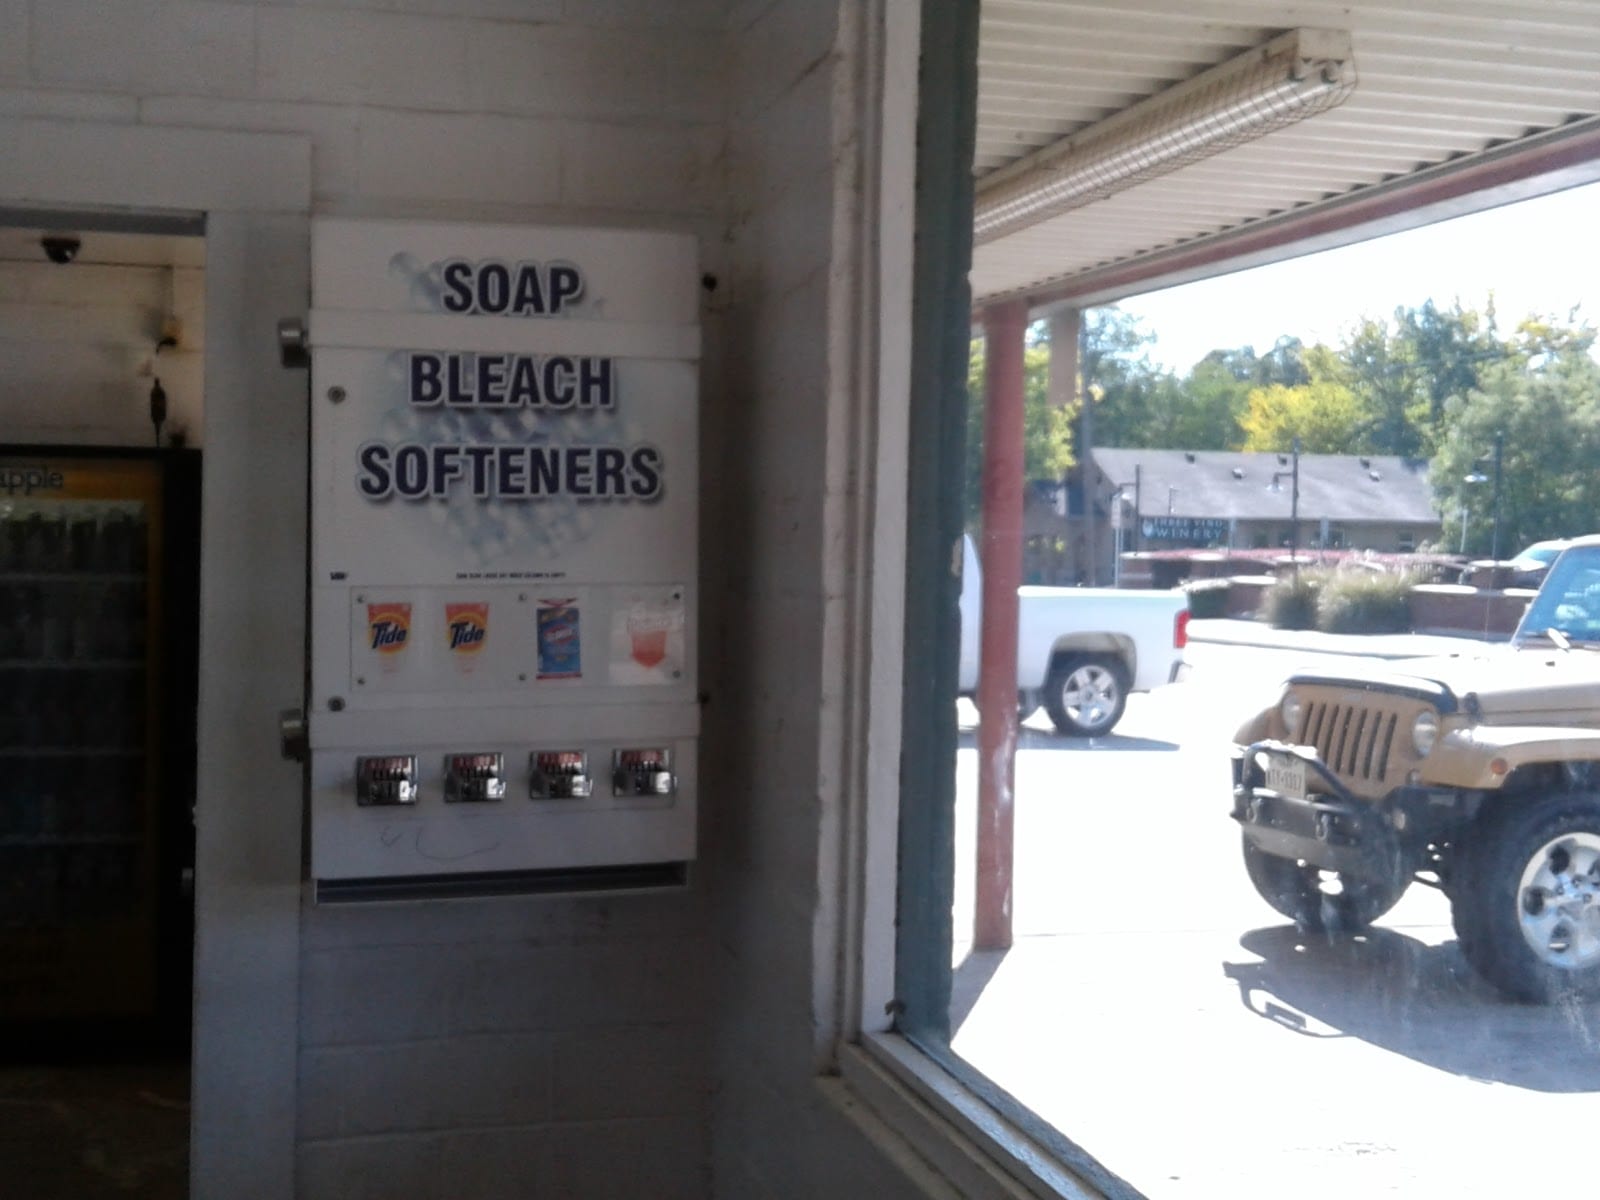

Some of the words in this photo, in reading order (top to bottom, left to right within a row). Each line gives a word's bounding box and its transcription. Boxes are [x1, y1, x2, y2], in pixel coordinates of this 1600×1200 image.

[442, 261, 581, 315] SOAP
[409, 353, 613, 406] BLEACH
[359, 444, 659, 495] SOFTENERS
[1156, 528, 1222, 538] WINERY
[371, 620, 408, 649] Tide
[449, 620, 486, 649] Tide
